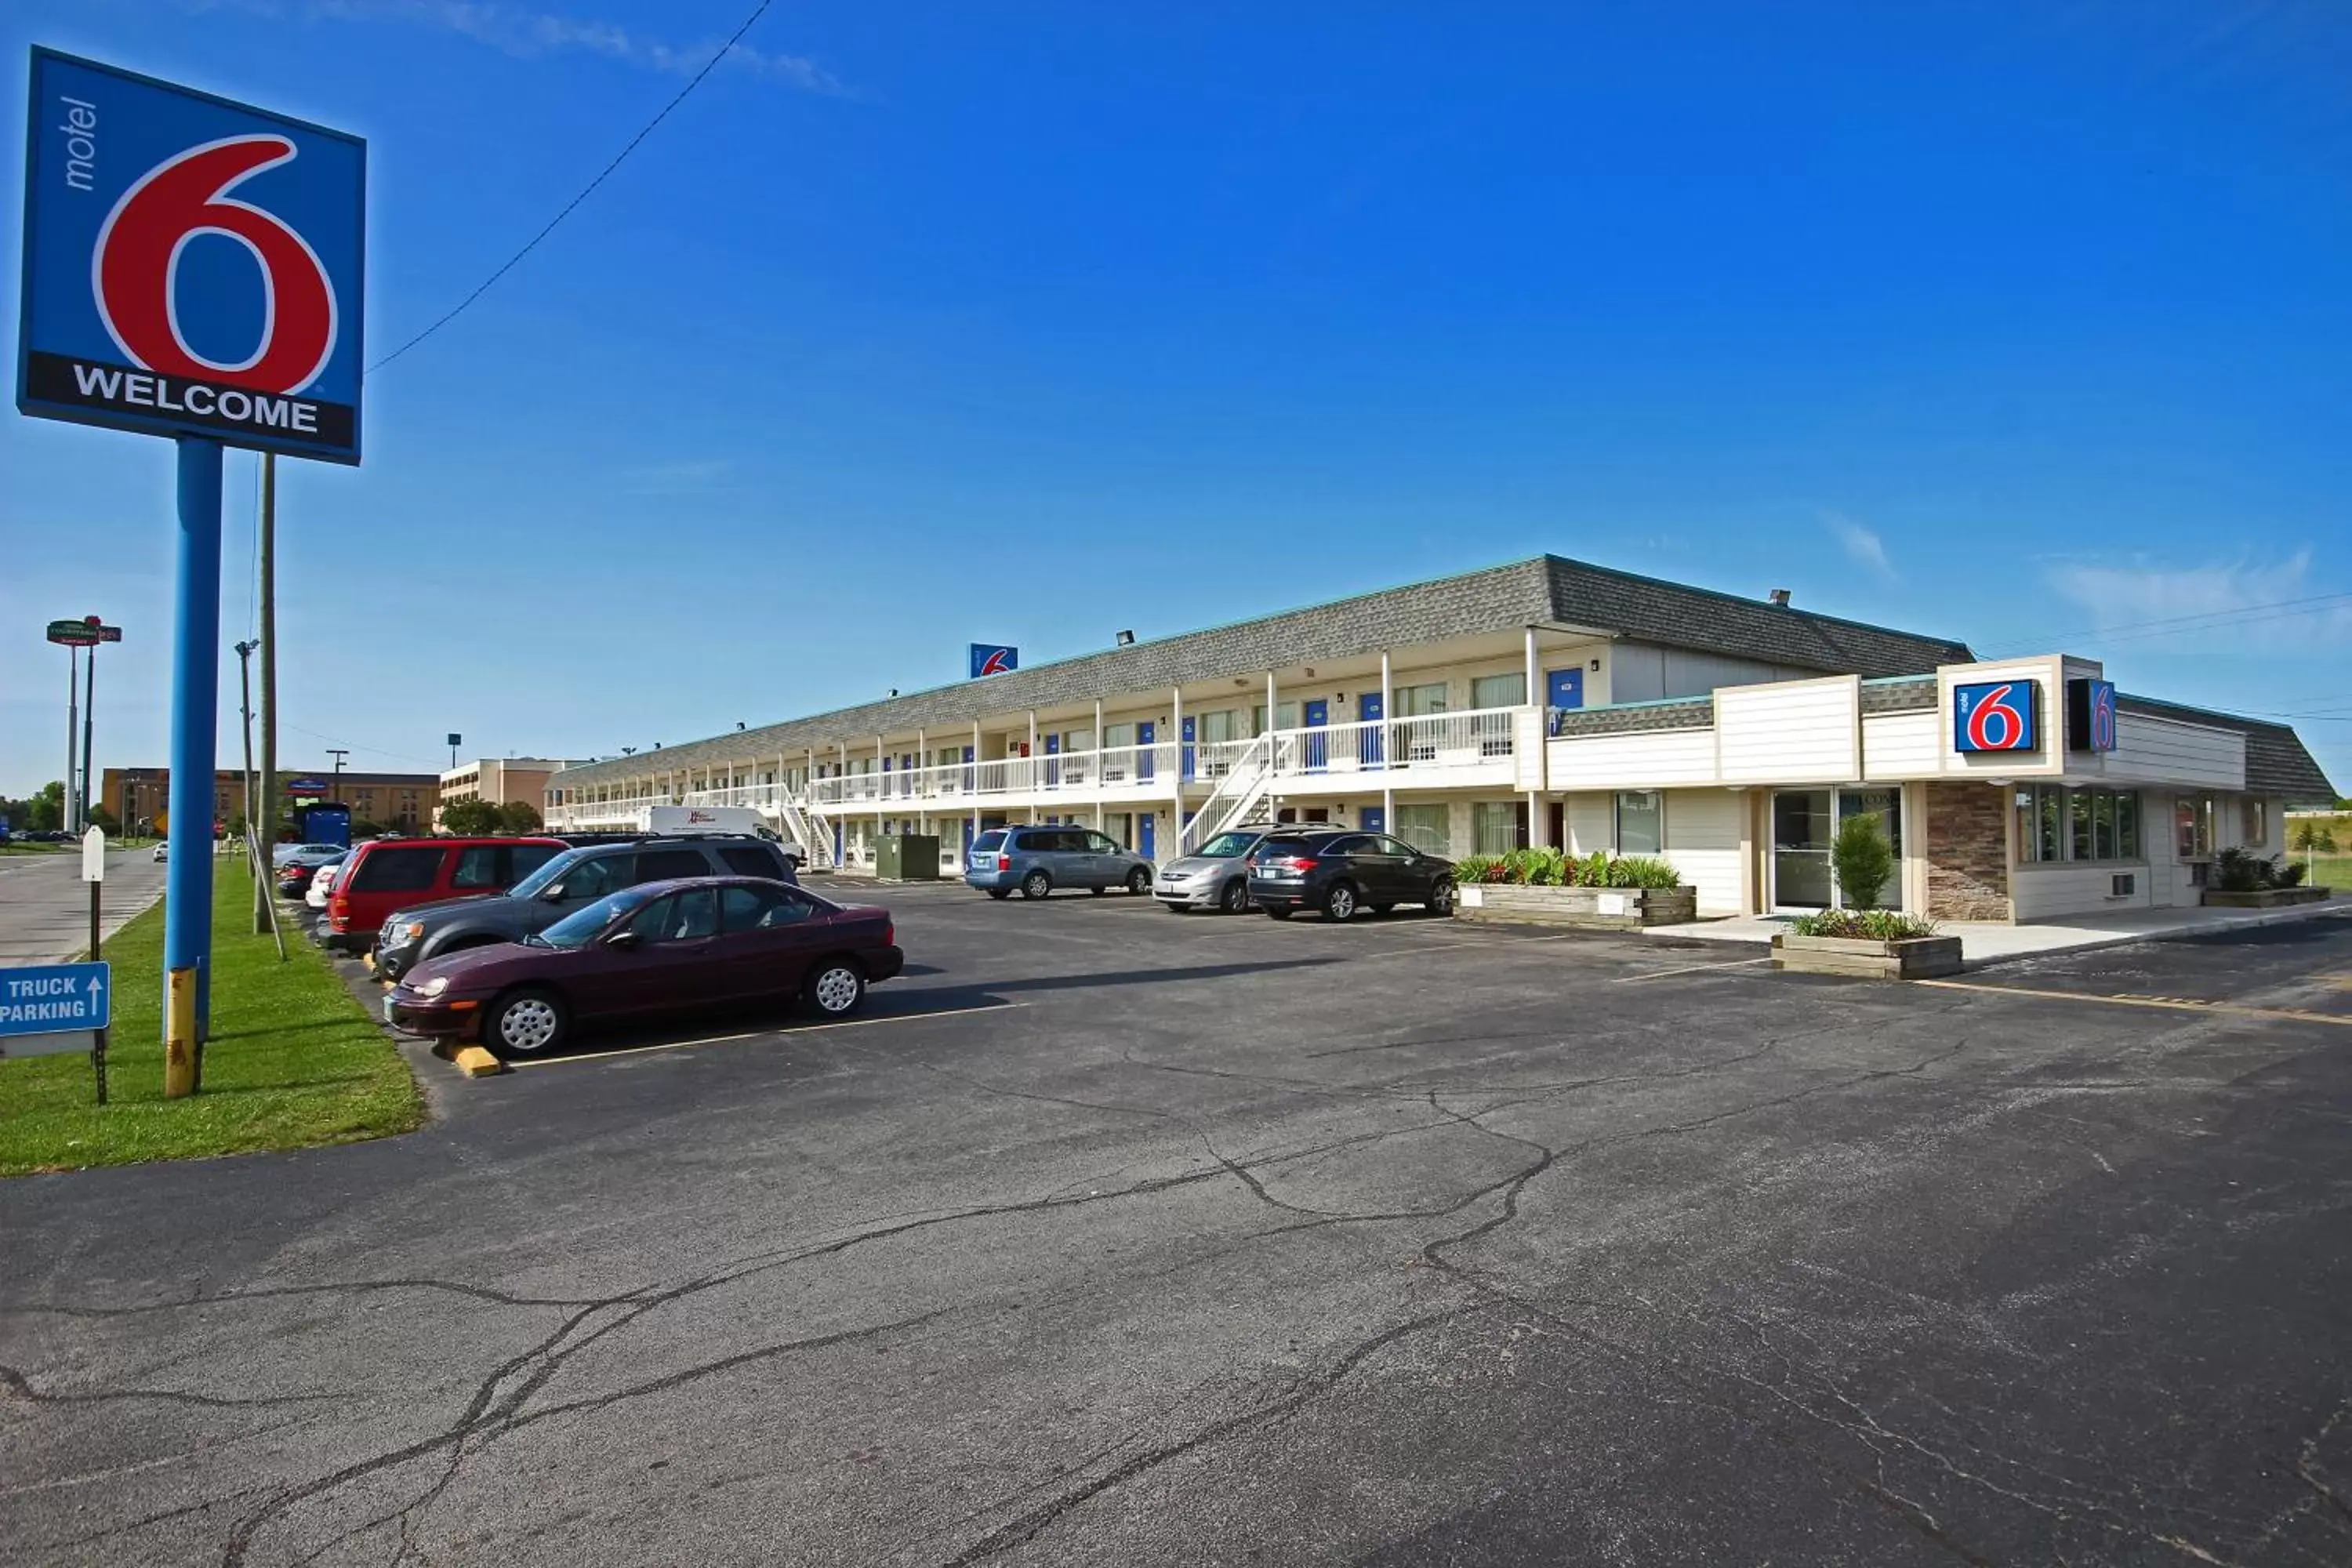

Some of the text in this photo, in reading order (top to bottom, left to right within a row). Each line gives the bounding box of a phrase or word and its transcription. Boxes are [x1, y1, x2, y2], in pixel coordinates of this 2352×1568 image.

[59, 96, 96, 191] motel
[92, 133, 338, 395] 6
[74, 365, 318, 433] WELCOME
[1968, 684, 2023, 750] 6
[2093, 686, 2112, 748] 6
[0, 1000, 85, 1022] PARKING
[8, 978, 76, 997] TRUCK
